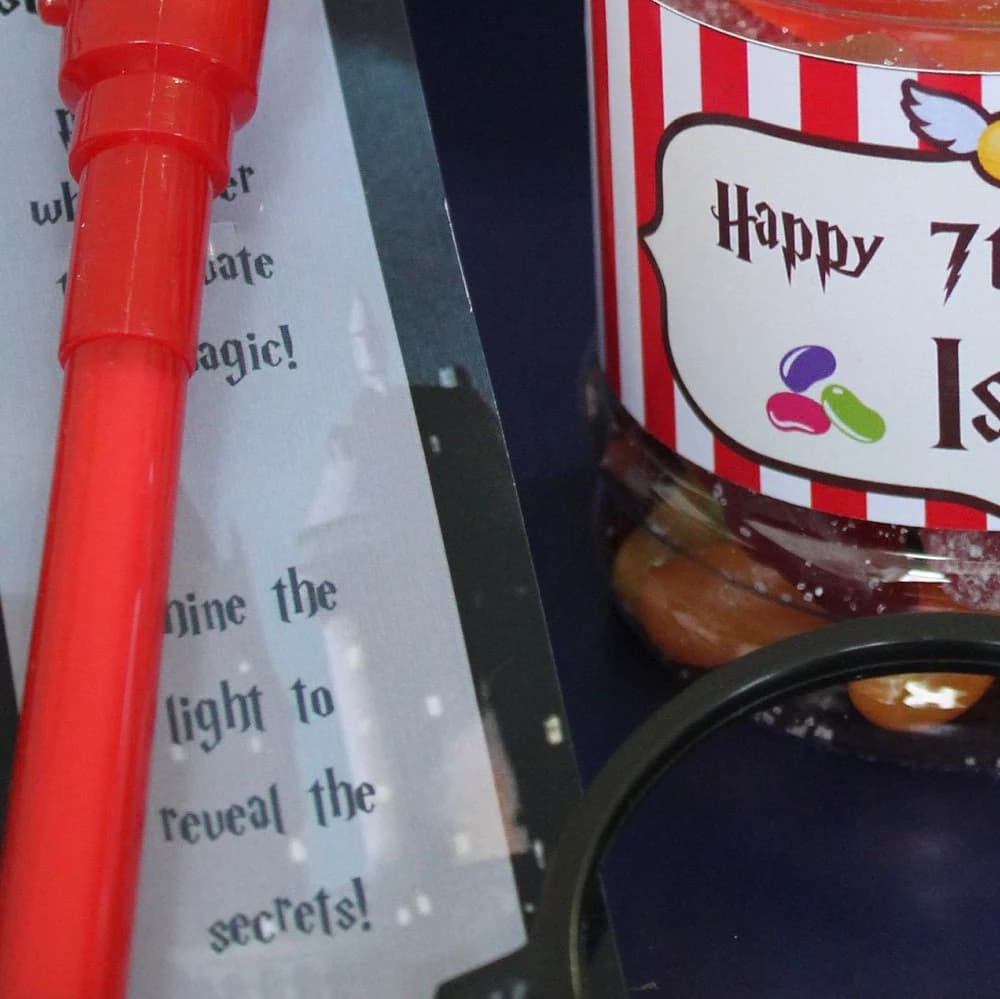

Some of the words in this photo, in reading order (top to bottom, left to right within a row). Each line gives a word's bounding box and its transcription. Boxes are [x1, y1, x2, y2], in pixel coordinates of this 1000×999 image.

[710, 178, 885, 294] Happy
[193, 324, 298, 387] agic!
[271, 566, 337, 623] the
[165, 679, 267, 754] light
[290, 677, 335, 725] to
[158, 782, 286, 845] reveal
[308, 766, 376, 828] the
[207, 877, 372, 954] secrets!
